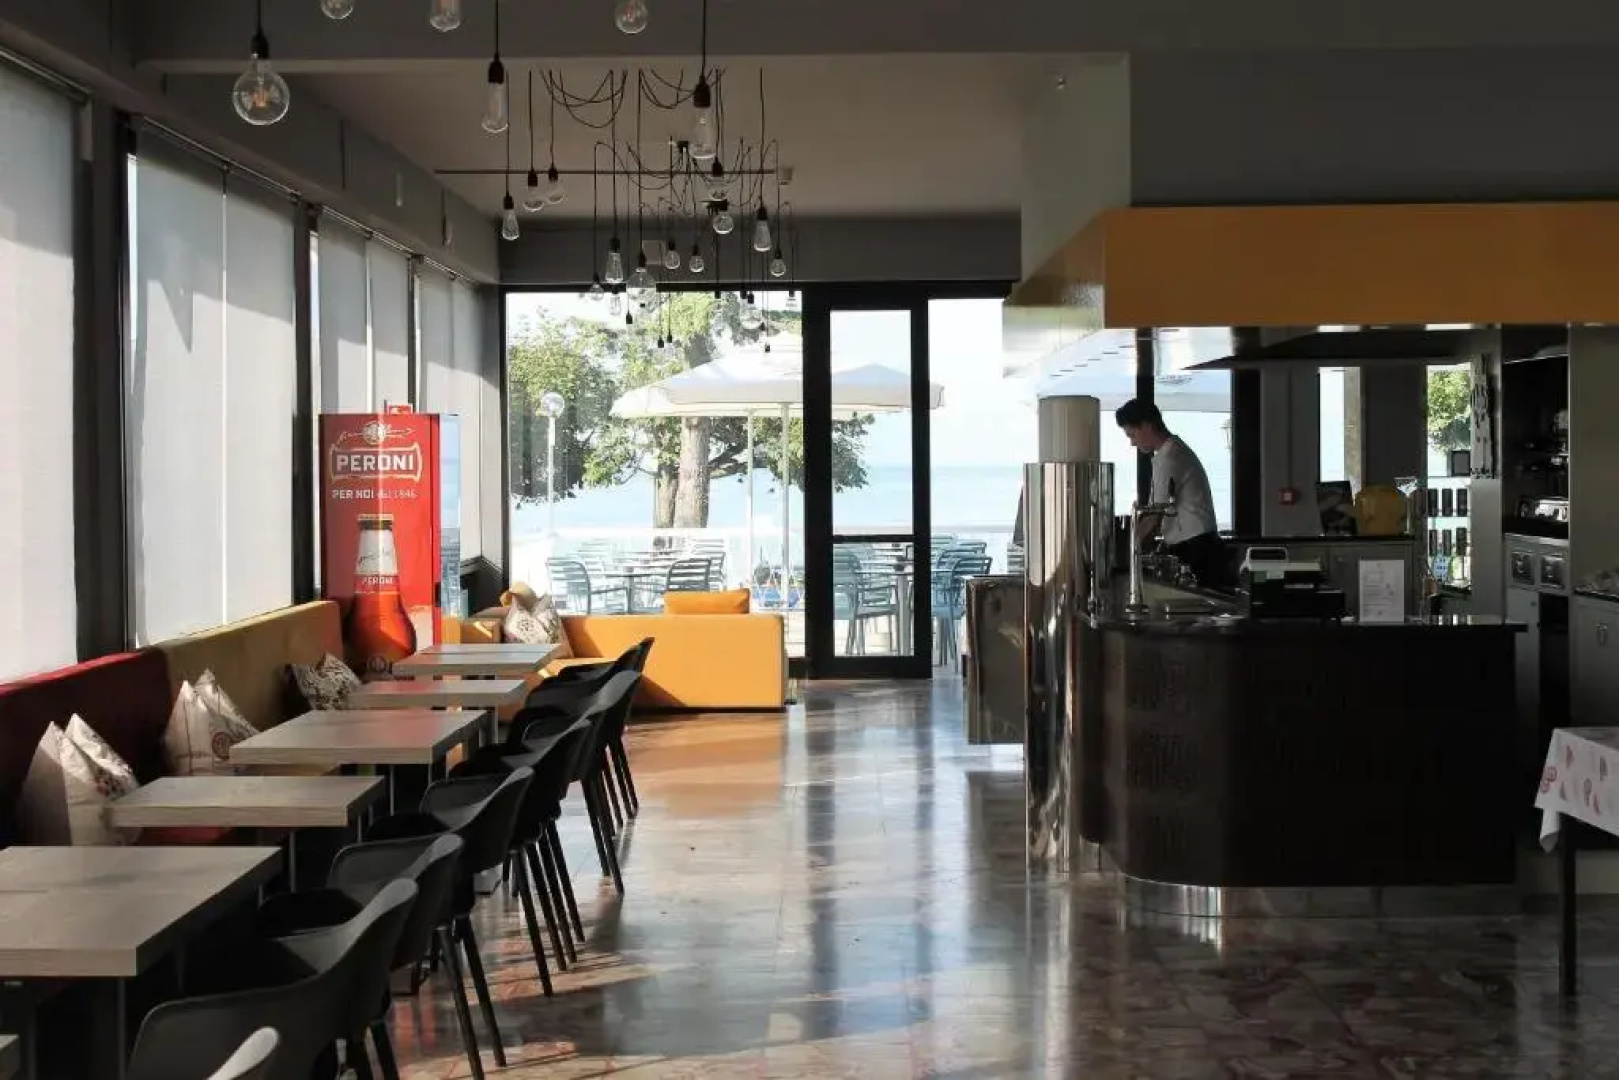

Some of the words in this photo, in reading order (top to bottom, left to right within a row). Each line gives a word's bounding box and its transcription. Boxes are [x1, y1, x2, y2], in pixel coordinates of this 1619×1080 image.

[336, 454, 414, 471] PERONI
[332, 489, 354, 499] PER
[355, 489, 374, 499] NOI
